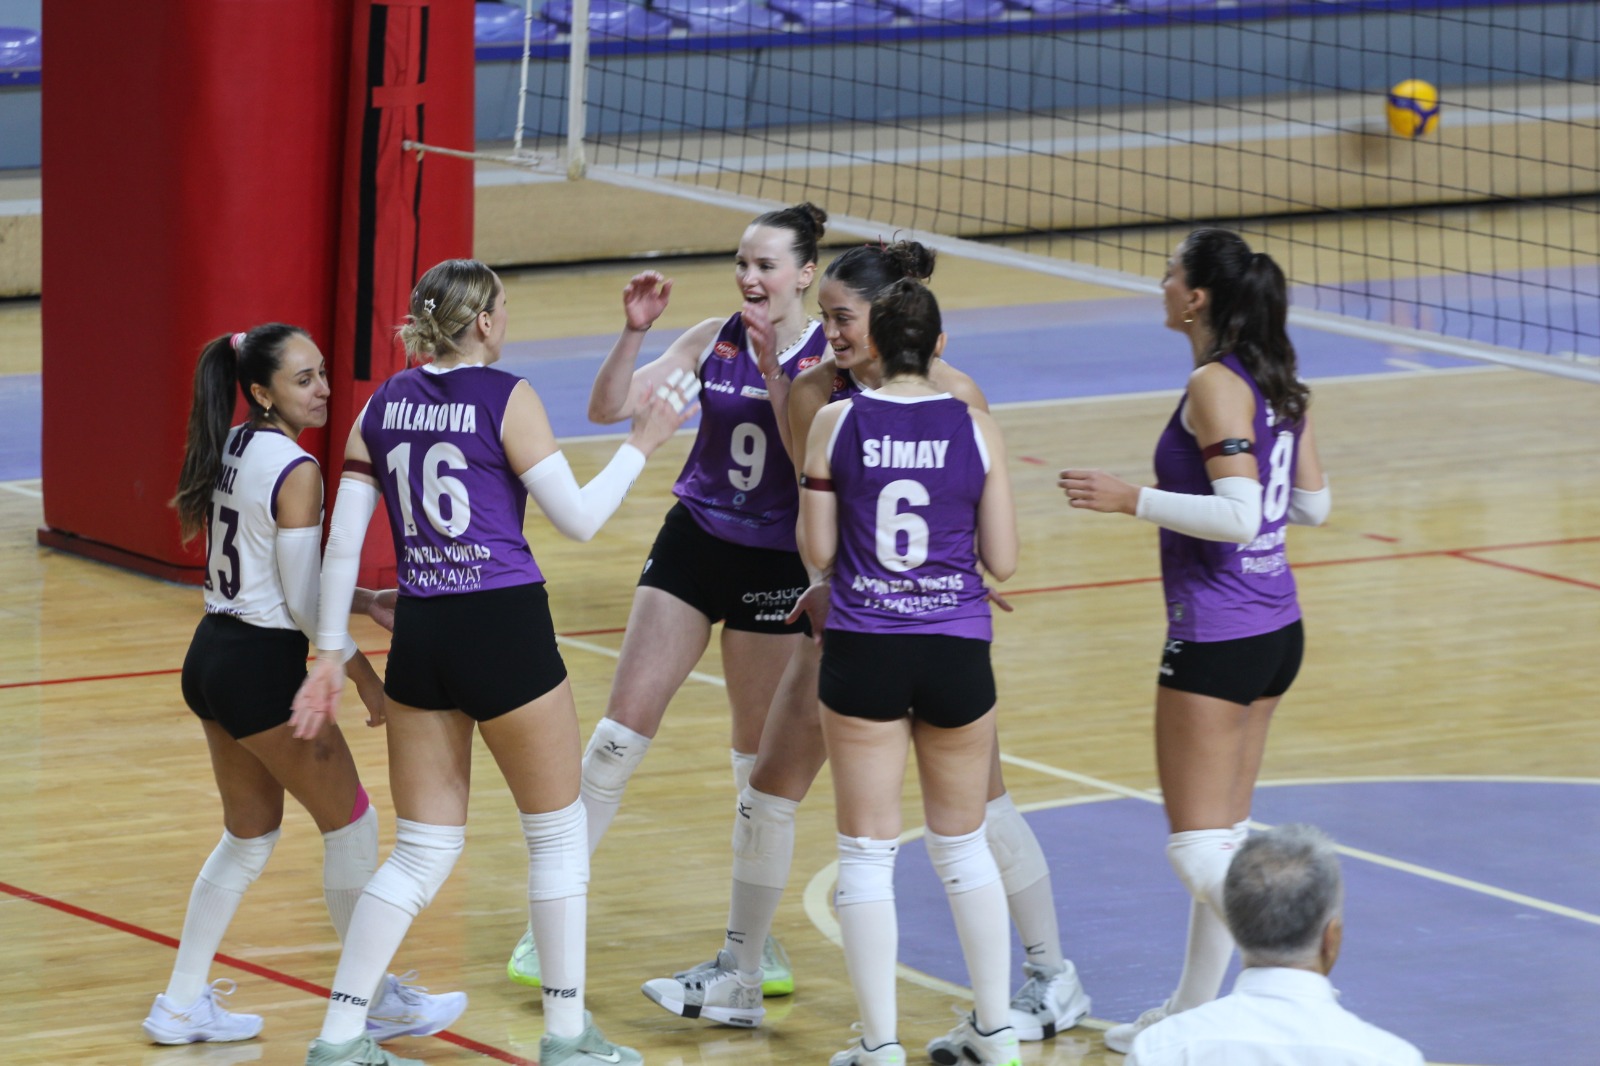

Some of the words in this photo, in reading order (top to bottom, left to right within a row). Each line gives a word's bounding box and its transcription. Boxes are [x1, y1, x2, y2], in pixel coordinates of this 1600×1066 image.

[386, 441, 471, 538] 16
[727, 422, 767, 492] 9
[862, 435, 949, 469] SİMAY
[1264, 430, 1295, 523] 8
[875, 479, 931, 573] 6
